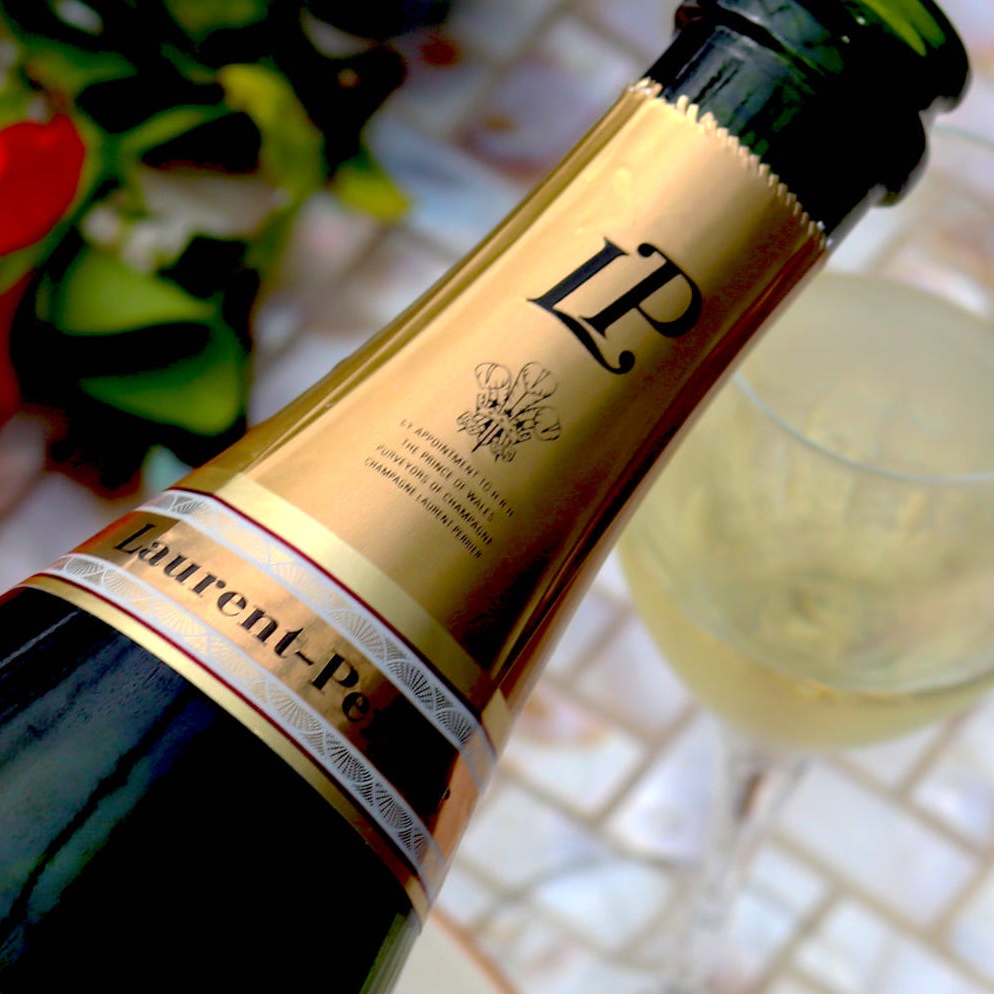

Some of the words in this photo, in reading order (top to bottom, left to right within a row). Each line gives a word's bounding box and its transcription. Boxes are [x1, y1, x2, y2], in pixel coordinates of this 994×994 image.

[364, 456, 417, 496] CHAMPAGNE
[402, 439, 420, 454] THE
[420, 451, 453, 479] PRINCE
[454, 479, 466, 491] OF
[467, 490, 494, 522] WALES
[414, 427, 479, 478] APPOINTMENT
[430, 481, 442, 493] OF
[443, 492, 493, 545] CHAMPAGNE
